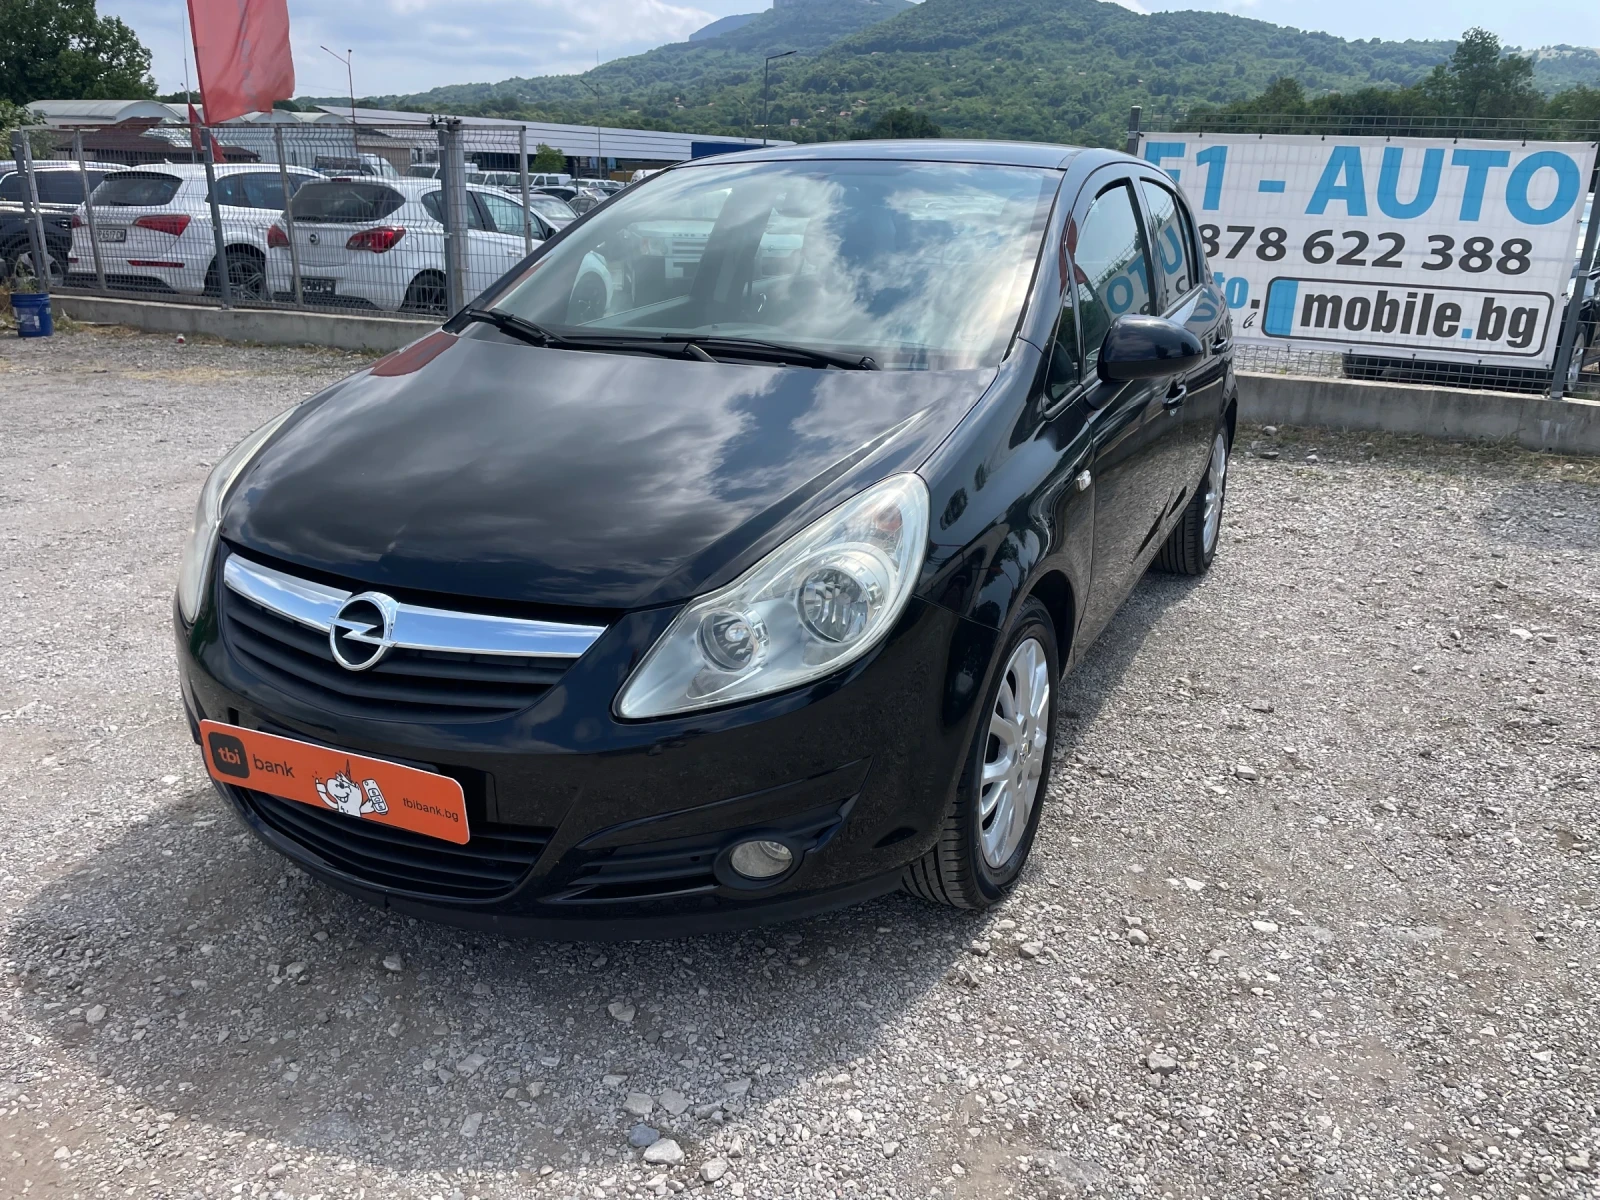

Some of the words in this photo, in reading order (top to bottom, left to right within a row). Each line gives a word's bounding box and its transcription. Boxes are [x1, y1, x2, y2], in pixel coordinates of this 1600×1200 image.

[1305, 145, 1581, 226] AUTO
[1302, 229, 1406, 269] 622
[1421, 234, 1533, 275] 388
[1299, 290, 1540, 349] mobile.bg
[218, 747, 241, 765] tbi
[252, 754, 295, 778] bank
[402, 798, 459, 823] tbibank.bg
